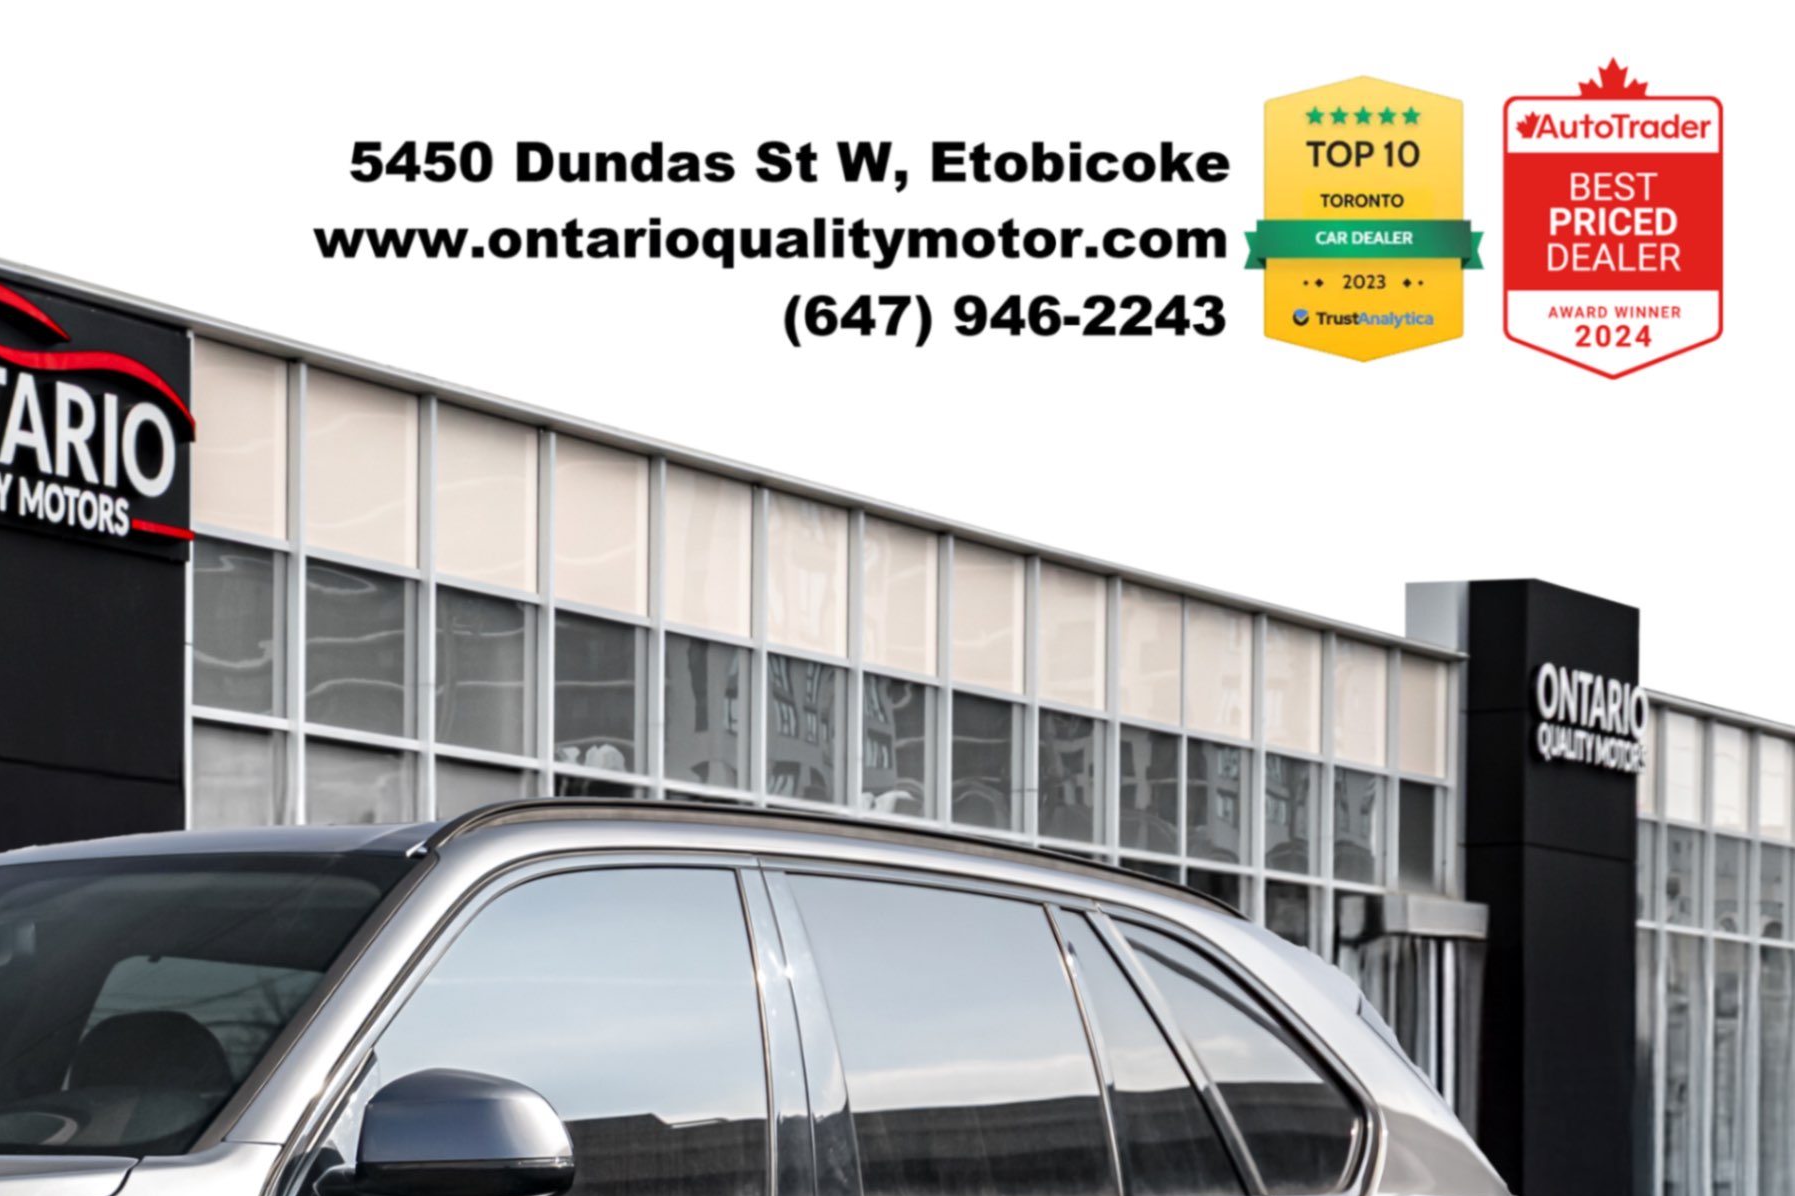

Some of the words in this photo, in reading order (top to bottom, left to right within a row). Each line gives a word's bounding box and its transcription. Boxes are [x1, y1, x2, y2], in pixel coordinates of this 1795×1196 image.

[18, 476, 131, 536] MOTORS
[1537, 662, 1649, 739] ONTARIO
[1537, 722, 1595, 763] QUALITY
[1595, 734, 1647, 774] MOTORS
